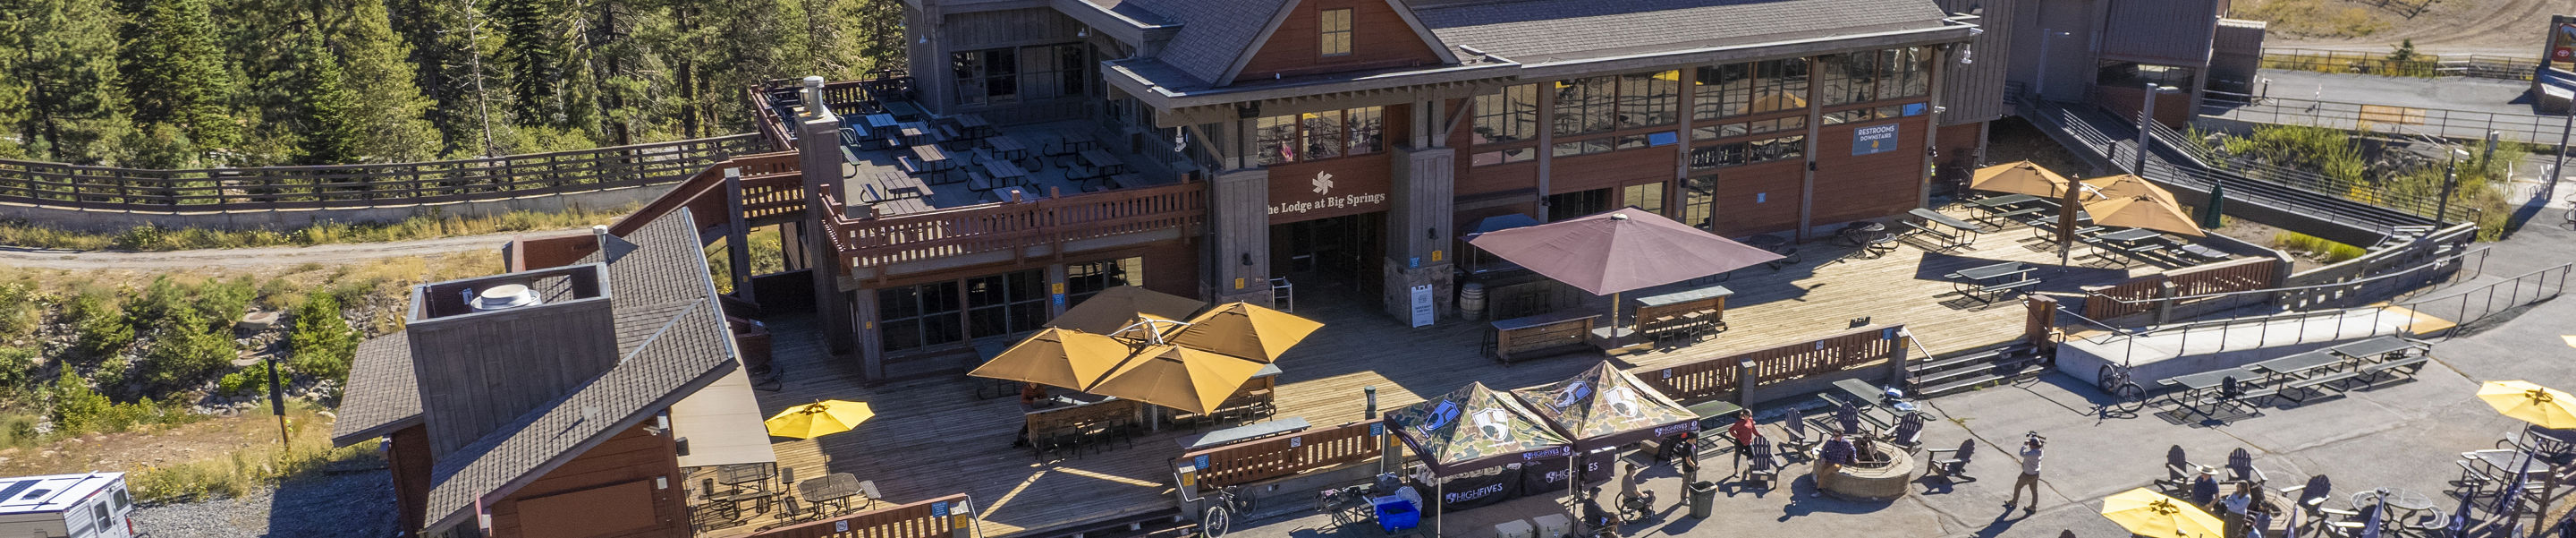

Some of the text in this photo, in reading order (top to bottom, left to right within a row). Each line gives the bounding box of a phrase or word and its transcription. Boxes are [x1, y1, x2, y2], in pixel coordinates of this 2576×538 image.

[1858, 125, 1895, 136] RESTROOMS
[1860, 132, 1892, 141] DOWNSTAIRS
[1267, 192, 1385, 215] he Lodge at Big Springs
[1456, 482, 1503, 501] HIGHFIVES
